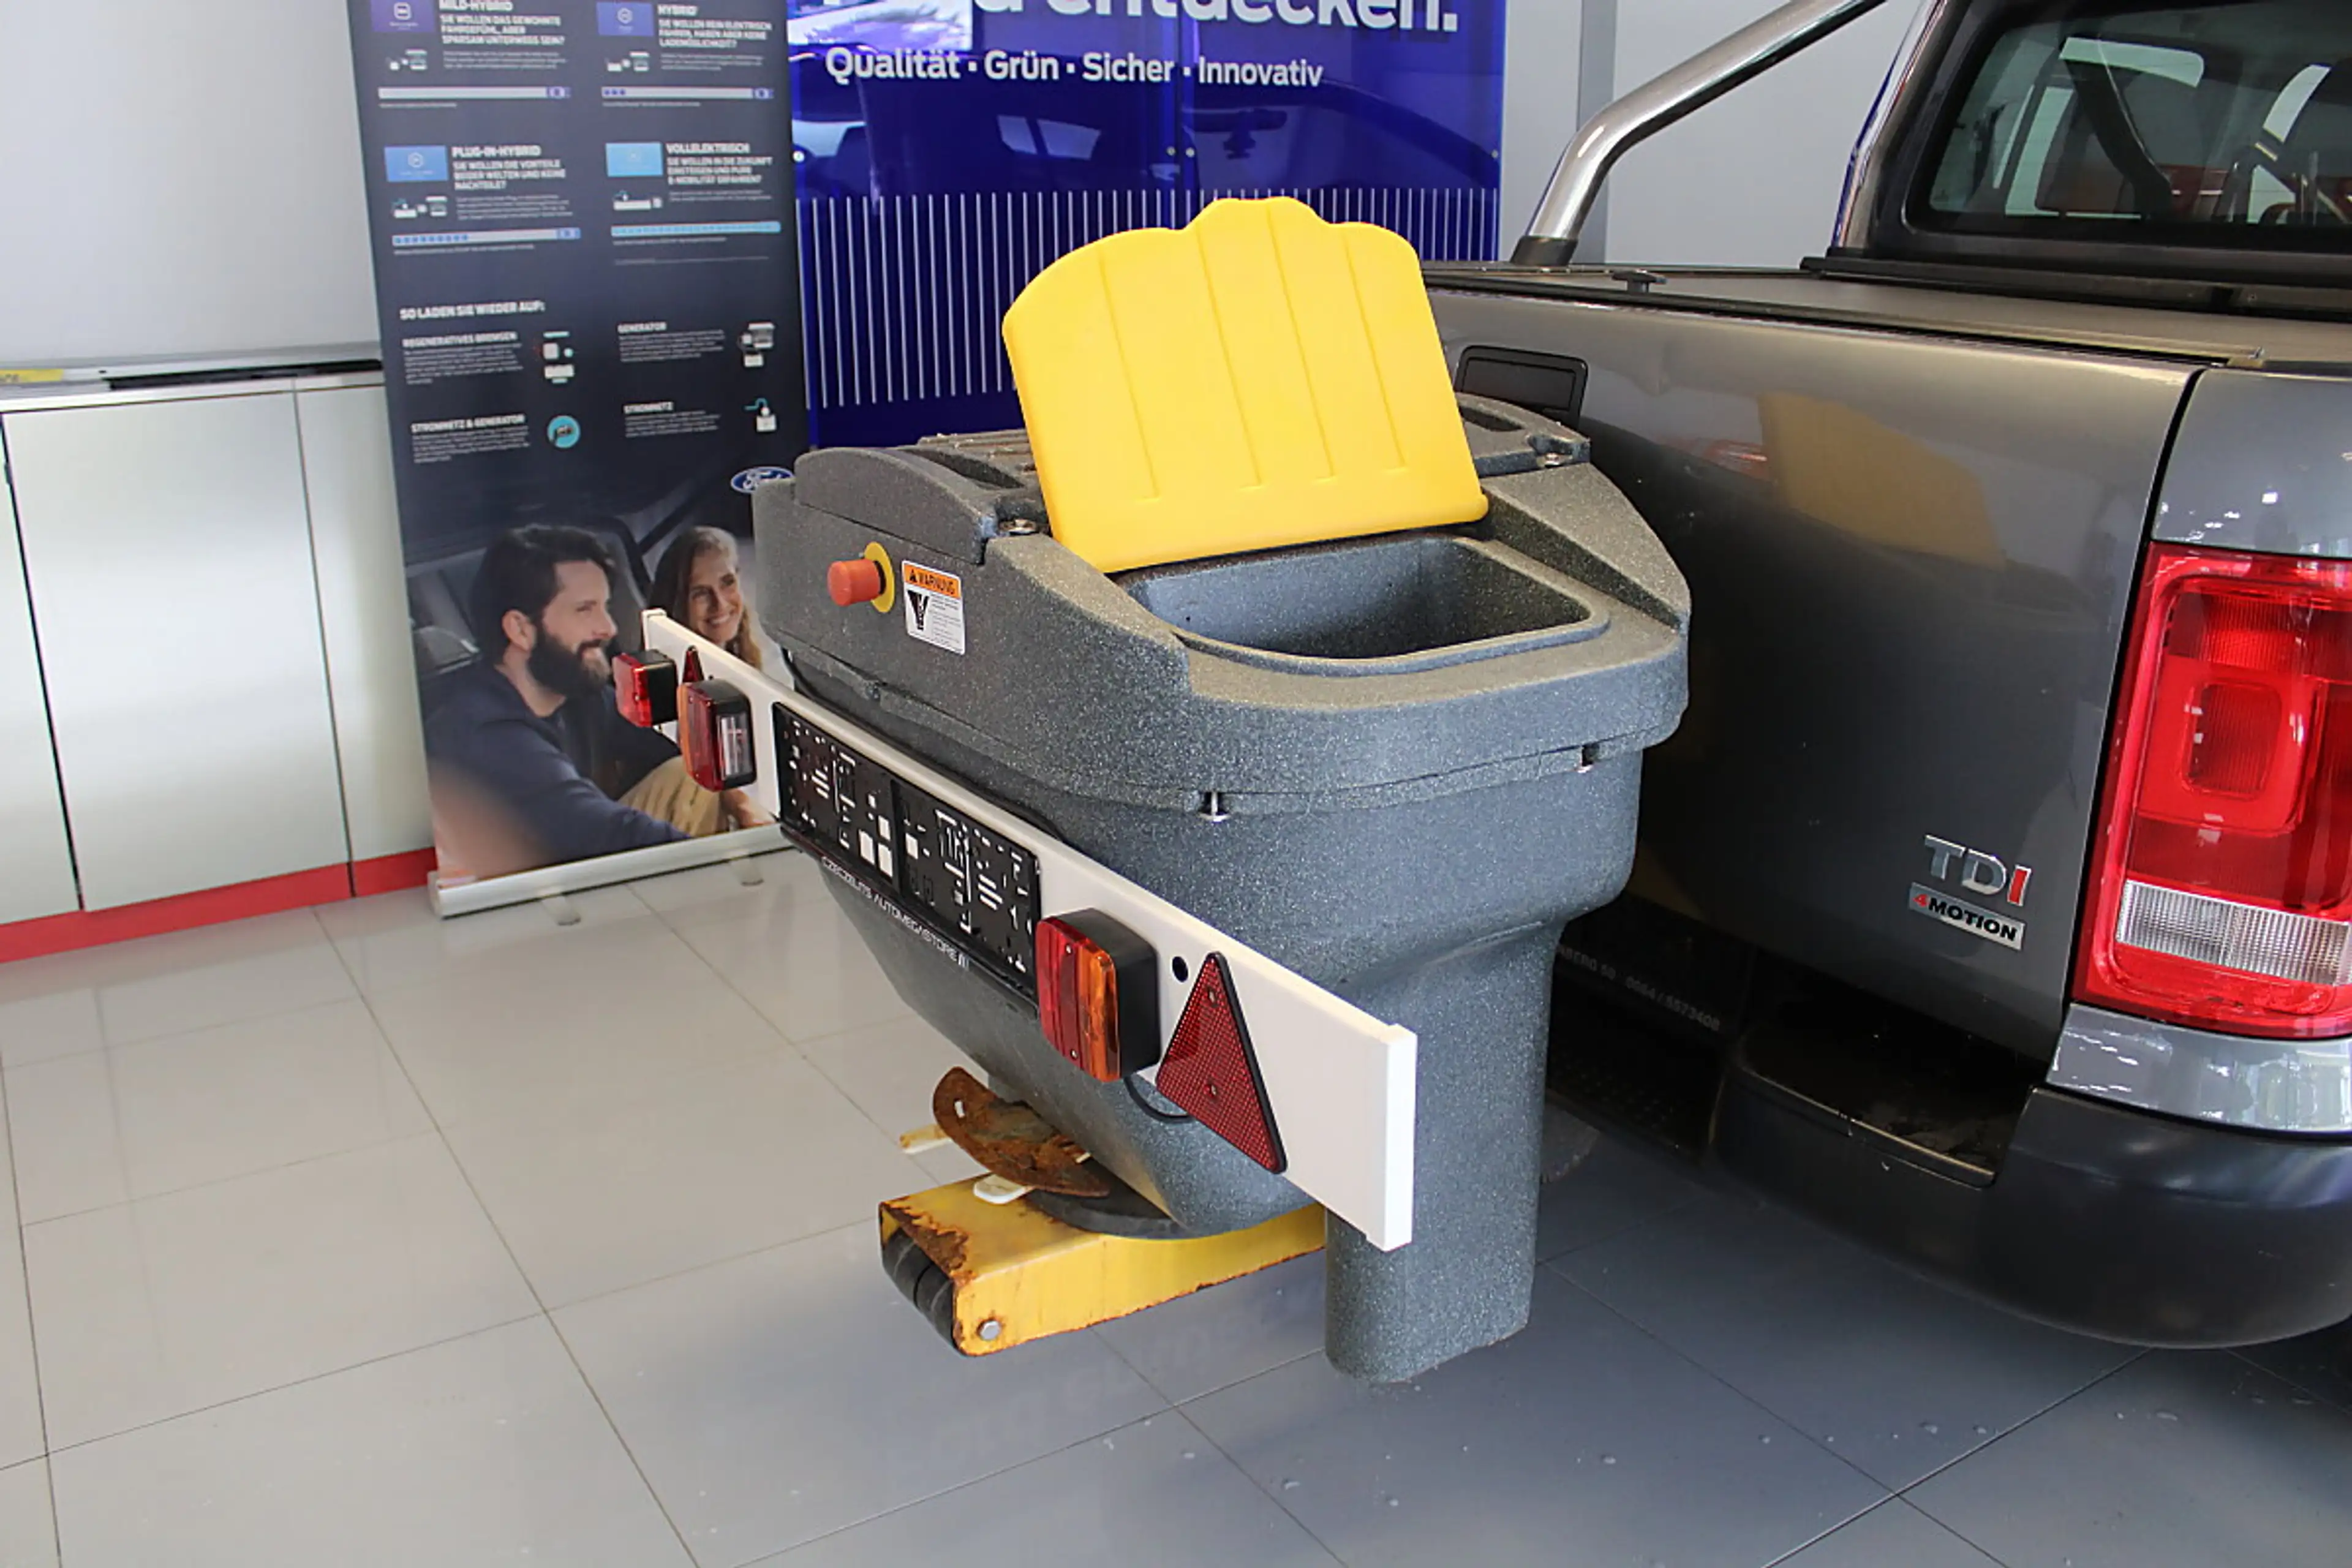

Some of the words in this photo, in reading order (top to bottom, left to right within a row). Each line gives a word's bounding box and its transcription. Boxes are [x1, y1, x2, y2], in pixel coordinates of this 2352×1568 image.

[825, 46, 961, 85] Qualität
[983, 48, 1059, 81] Grün
[1082, 50, 1175, 83] Sicher
[1199, 56, 1324, 87] Innovativ
[451, 145, 542, 158] PLUG-IN-HYBRID
[665, 142, 750, 155] VOLLELEKTRISCH
[399, 307, 417, 320] SO
[417, 306, 456, 319] LADEN
[456, 304, 475, 317] SIE
[475, 301, 517, 315] WIEDER
[1924, 834, 2032, 907] TDI
[1912, 893, 2018, 941] 4MOTION
